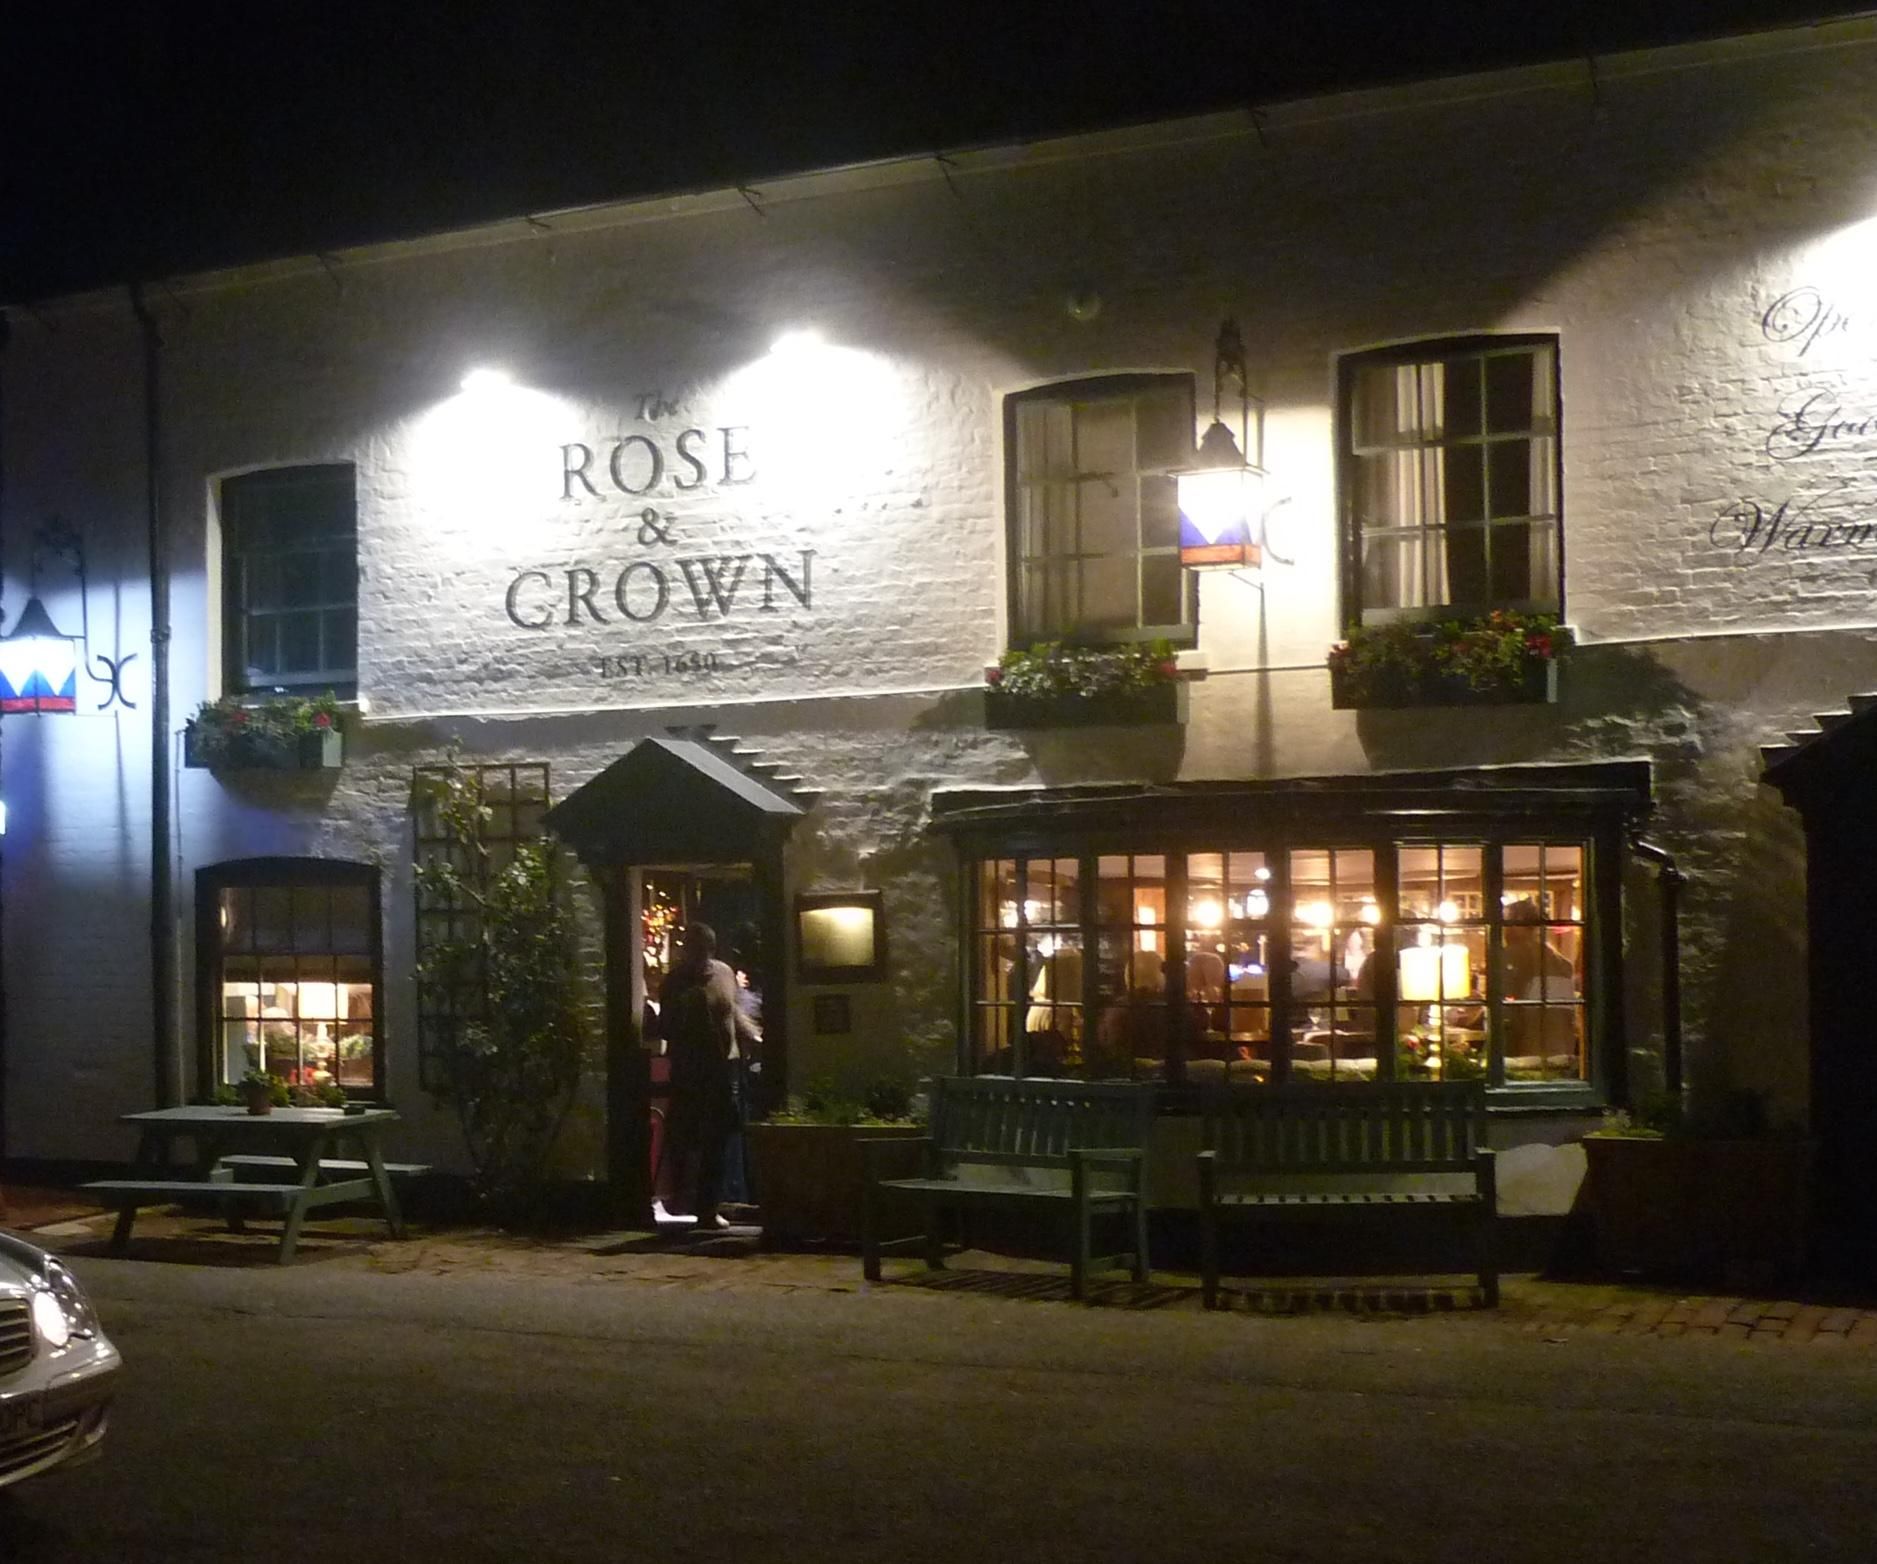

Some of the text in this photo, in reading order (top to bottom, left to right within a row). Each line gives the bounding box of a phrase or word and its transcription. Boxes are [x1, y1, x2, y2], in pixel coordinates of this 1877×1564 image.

[634, 390, 682, 421] The
[560, 426, 756, 501] ROSE
[637, 506, 678, 546] &
[505, 549, 817, 630] CROWN
